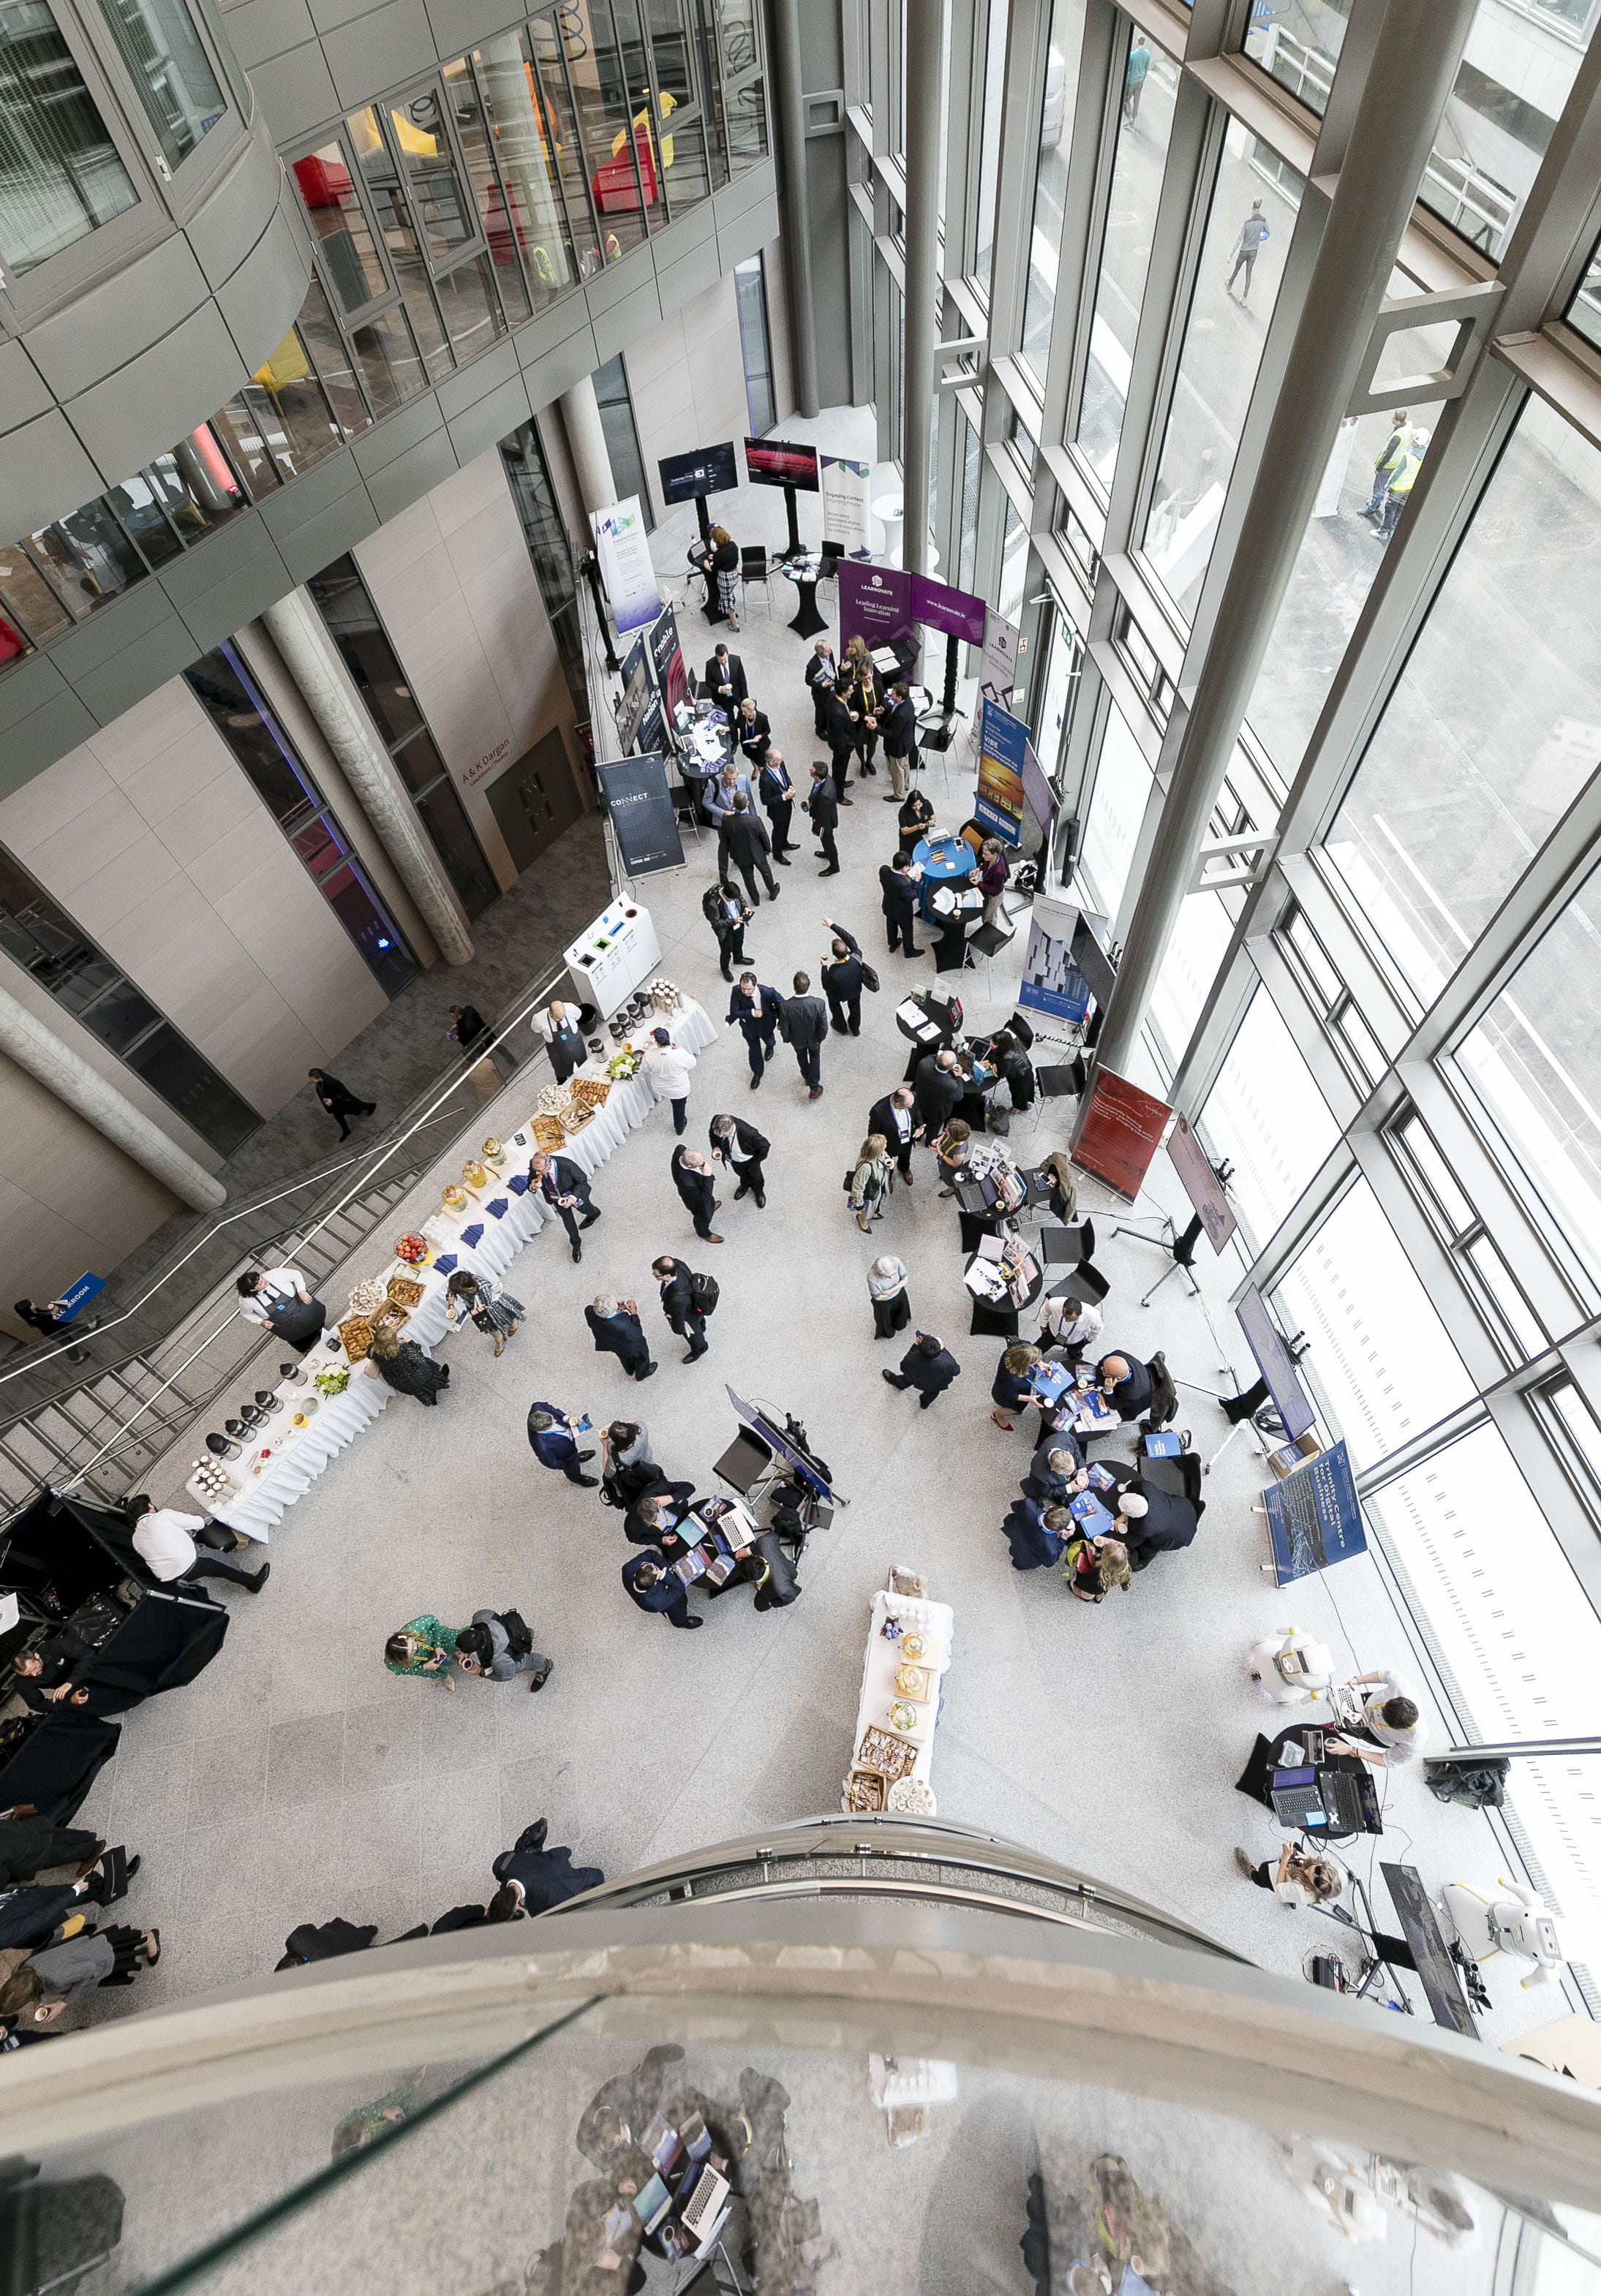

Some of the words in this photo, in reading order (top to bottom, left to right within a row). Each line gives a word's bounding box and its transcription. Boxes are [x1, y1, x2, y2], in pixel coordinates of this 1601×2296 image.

[861, 584, 893, 596] LEARNOVATE
[856, 599, 875, 608] Leading
[876, 603, 900, 613] Learning
[864, 606, 891, 616] Innovation
[984, 735, 998, 749] VIBE
[462, 774, 469, 784] A
[469, 768, 475, 777] &
[475, 760, 482, 771] K
[482, 739, 510, 766] Dargan
[1314, 1467, 1328, 1521] Business
[1319, 1462, 1327, 1481] for
[1324, 1484, 1336, 1526] Digital
[1325, 1459, 1336, 1501] Trinity
[1334, 1504, 1345, 1548] Centre
